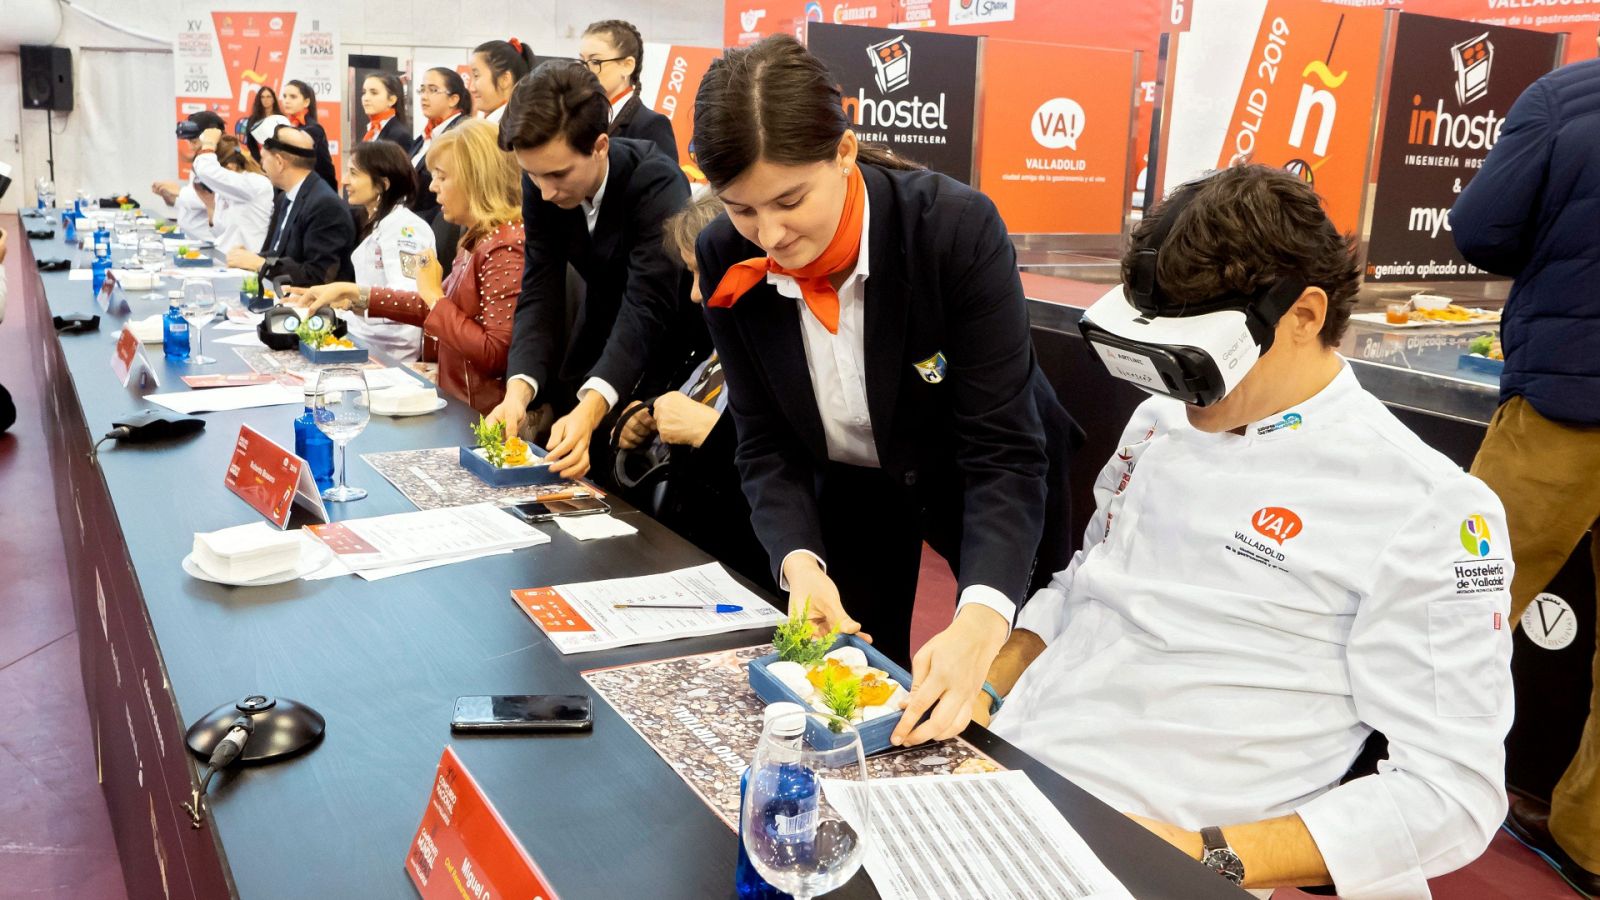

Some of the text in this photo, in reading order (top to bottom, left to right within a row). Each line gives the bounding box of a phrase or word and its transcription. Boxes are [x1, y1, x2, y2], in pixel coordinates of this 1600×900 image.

[833, 3, 877, 25] Cámara
[1508, 15, 1521, 25] de
[187, 20, 202, 32] XV
[310, 46, 334, 55] TAPAS
[1258, 17, 1290, 84] 2019
[668, 56, 688, 93] 2019
[184, 80, 210, 93] 2019
[308, 82, 332, 95] 019
[841, 88, 948, 129] nhostel
[1039, 112, 1075, 138] VA!
[894, 134, 947, 144] HOSTELERA
[1026, 158, 1086, 171] VALLADOLID
[1405, 154, 1459, 168] INGENIERÍA
[1452, 177, 1462, 193] &
[1367, 260, 1414, 279] ingeniería
[1257, 508, 1295, 539] VA!
[1234, 531, 1286, 562] VALLADOLID
[1454, 563, 1504, 579] Hostelería
[1457, 579, 1469, 589] de
[1533, 599, 1570, 637] V
[670, 705, 721, 747] VIRTUAL
[461, 857, 485, 898] Miguel
